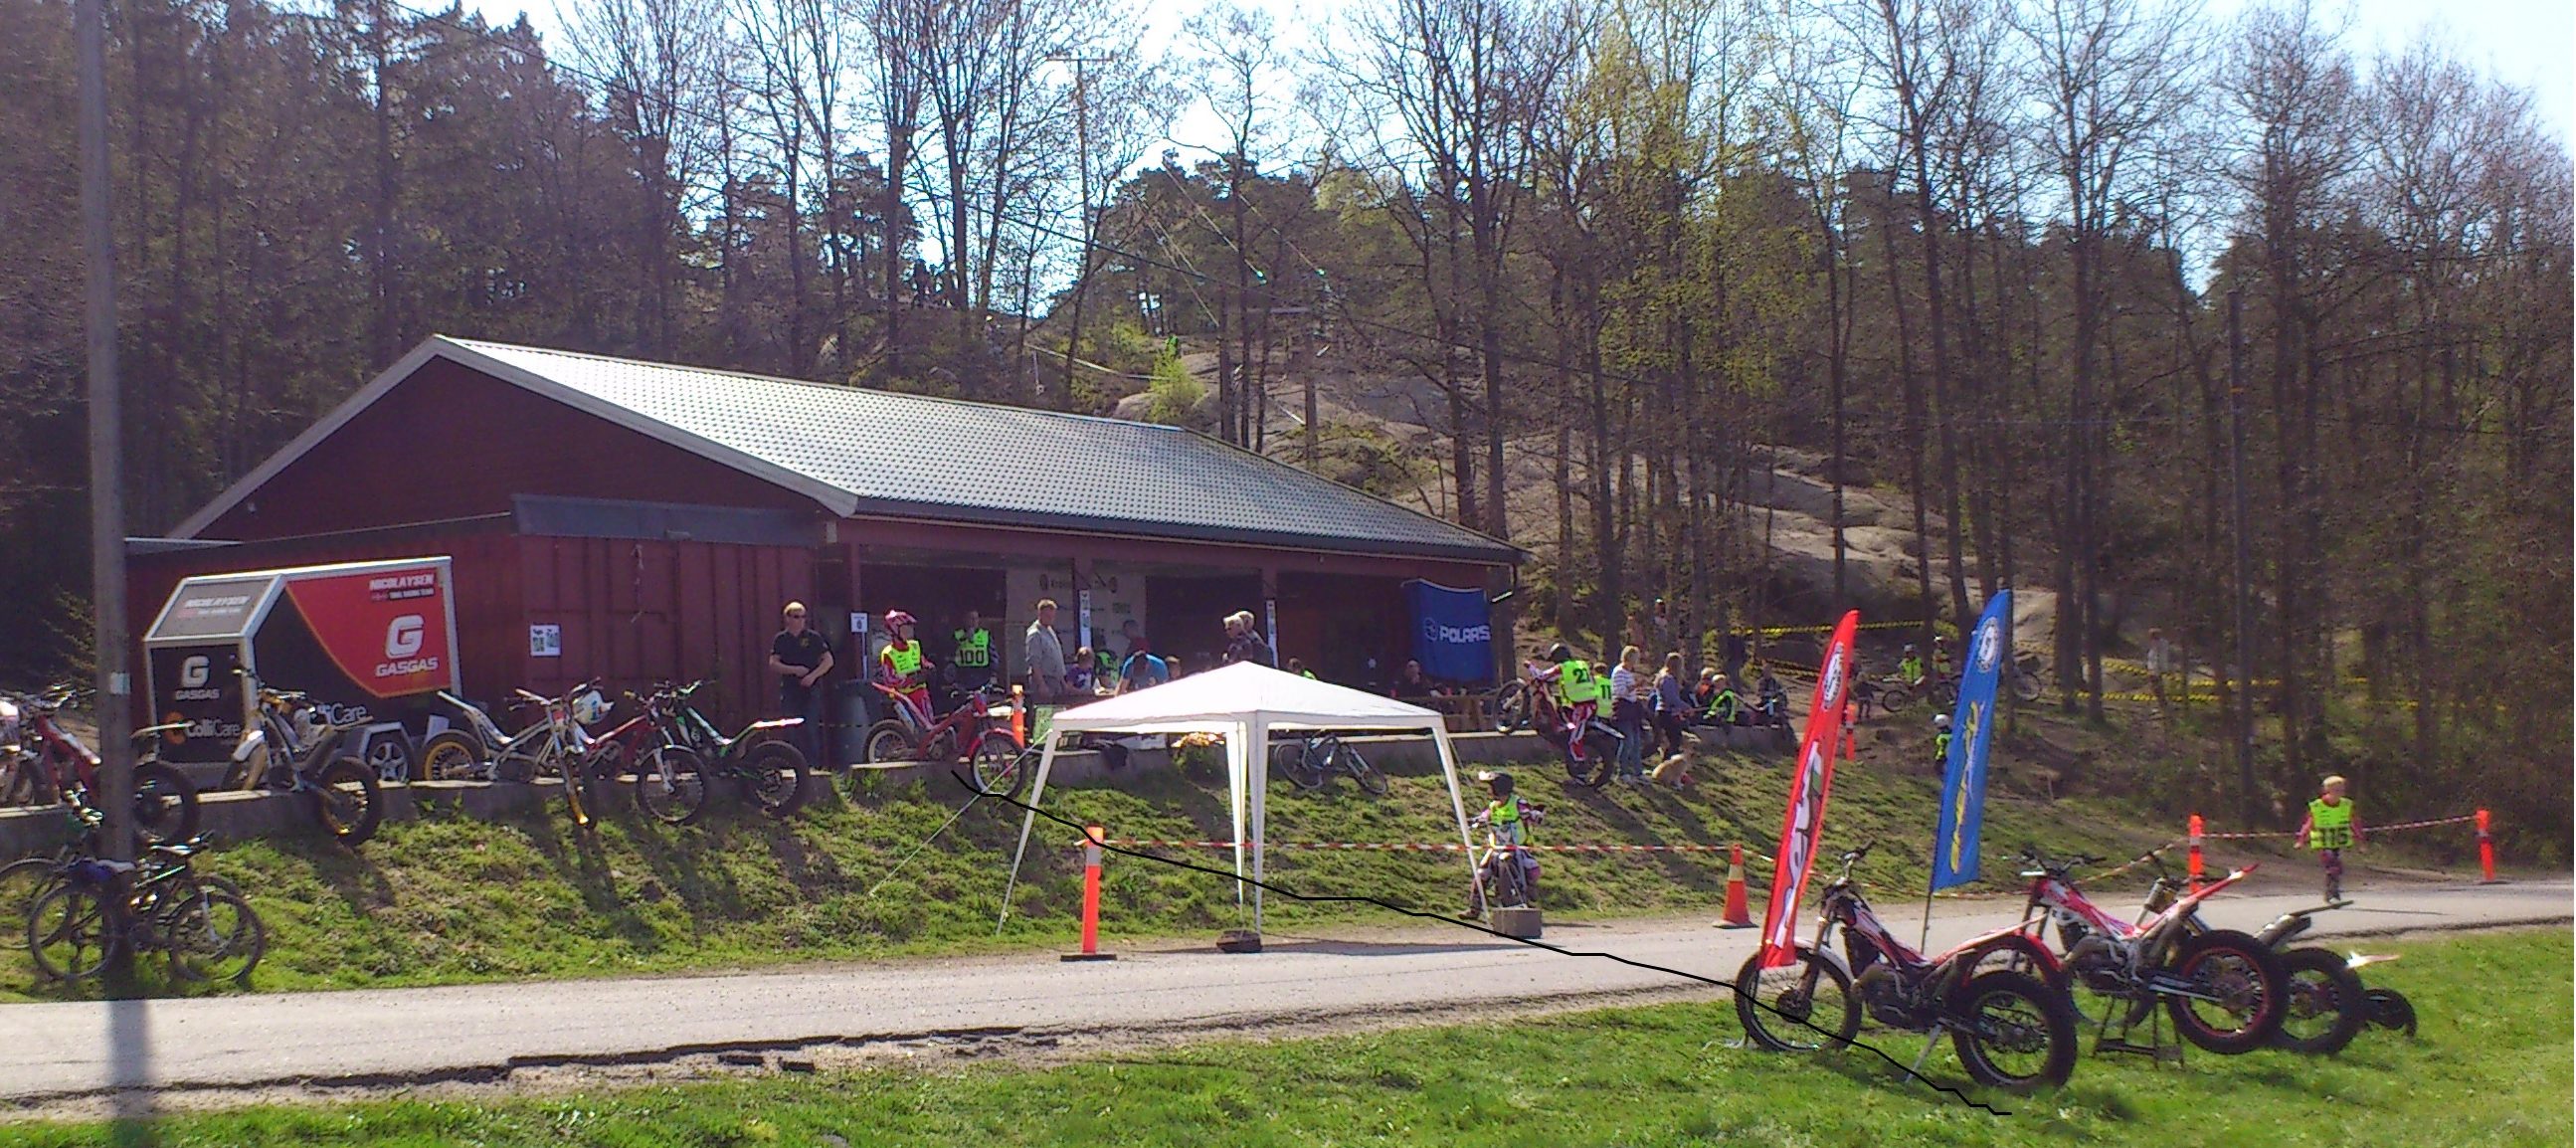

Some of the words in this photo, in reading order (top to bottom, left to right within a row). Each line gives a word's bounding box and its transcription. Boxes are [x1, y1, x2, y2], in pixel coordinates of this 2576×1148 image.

[386, 615, 424, 659] G
[1439, 624, 1491, 643] POLARS
[960, 650, 985, 665] 100
[376, 658, 439, 676] GASGAS
[175, 689, 220, 700] GASGAS
